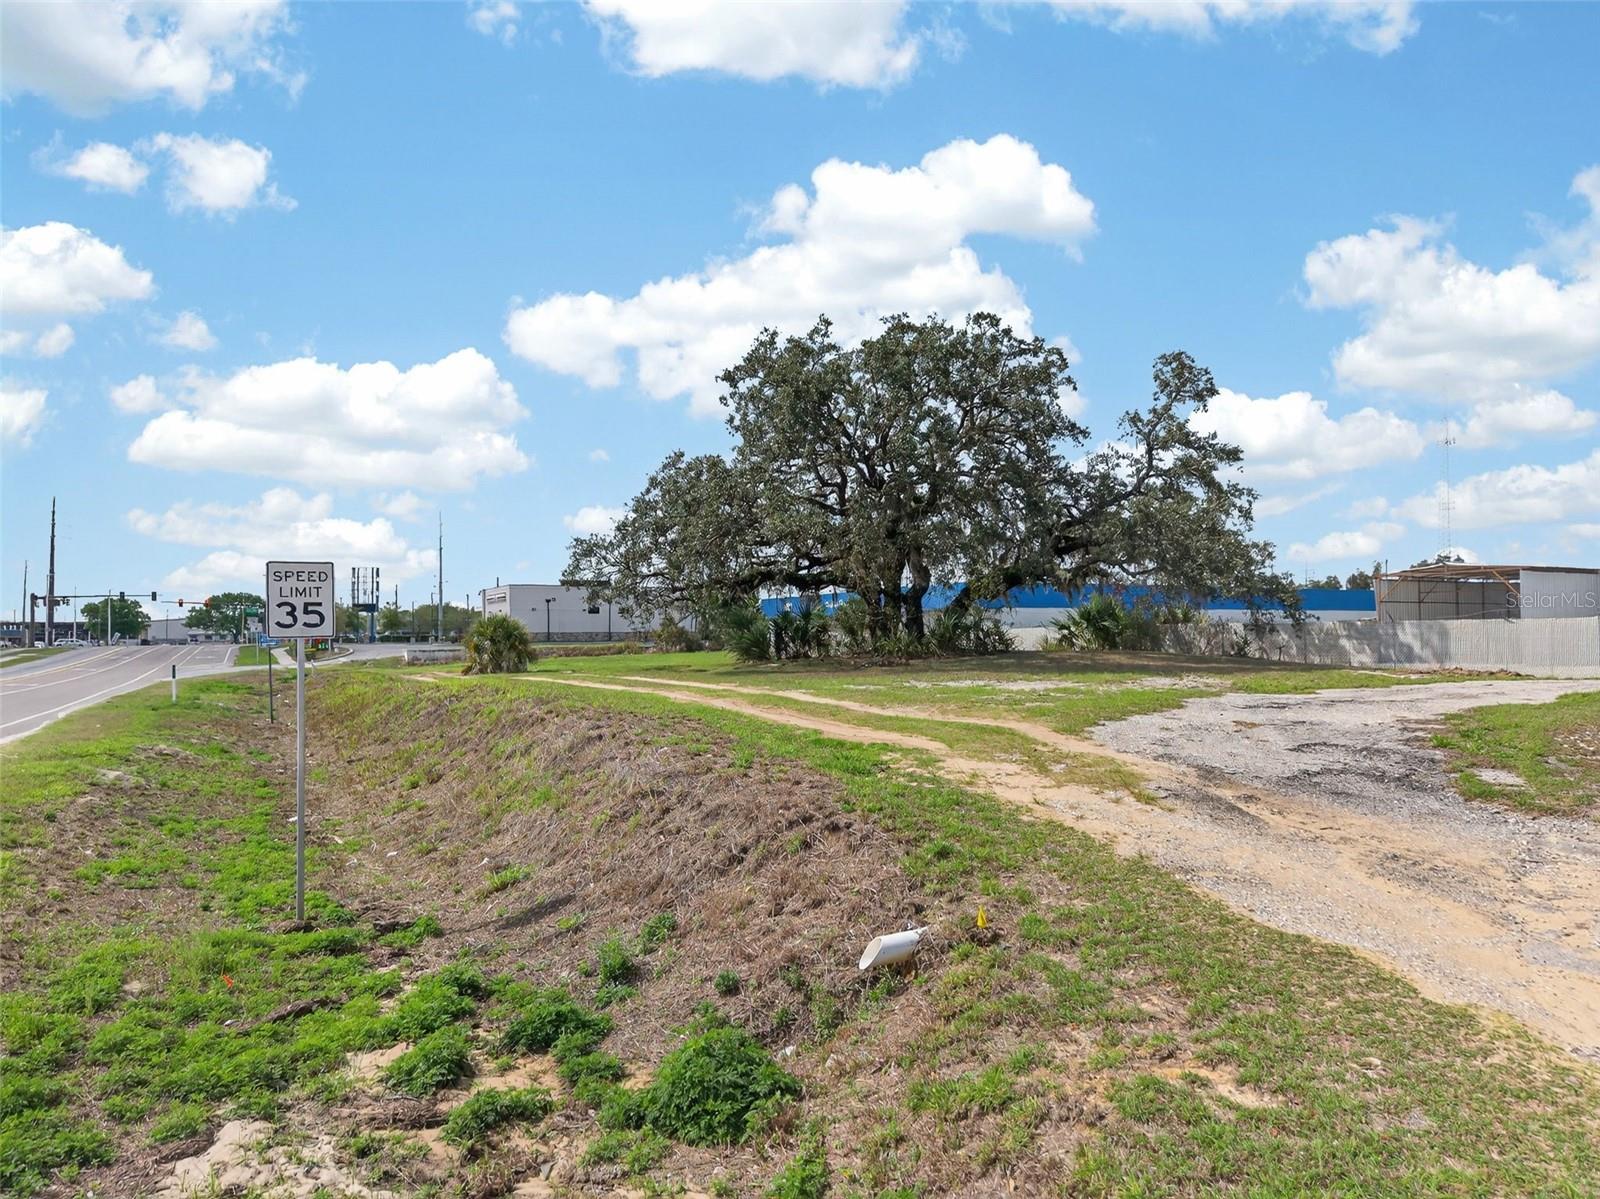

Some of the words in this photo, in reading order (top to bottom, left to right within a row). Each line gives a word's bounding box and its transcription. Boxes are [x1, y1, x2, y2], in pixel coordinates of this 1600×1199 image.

[273, 570, 328, 582] SPEED
[279, 586, 322, 598] LIMIT
[274, 601, 325, 628] 35
